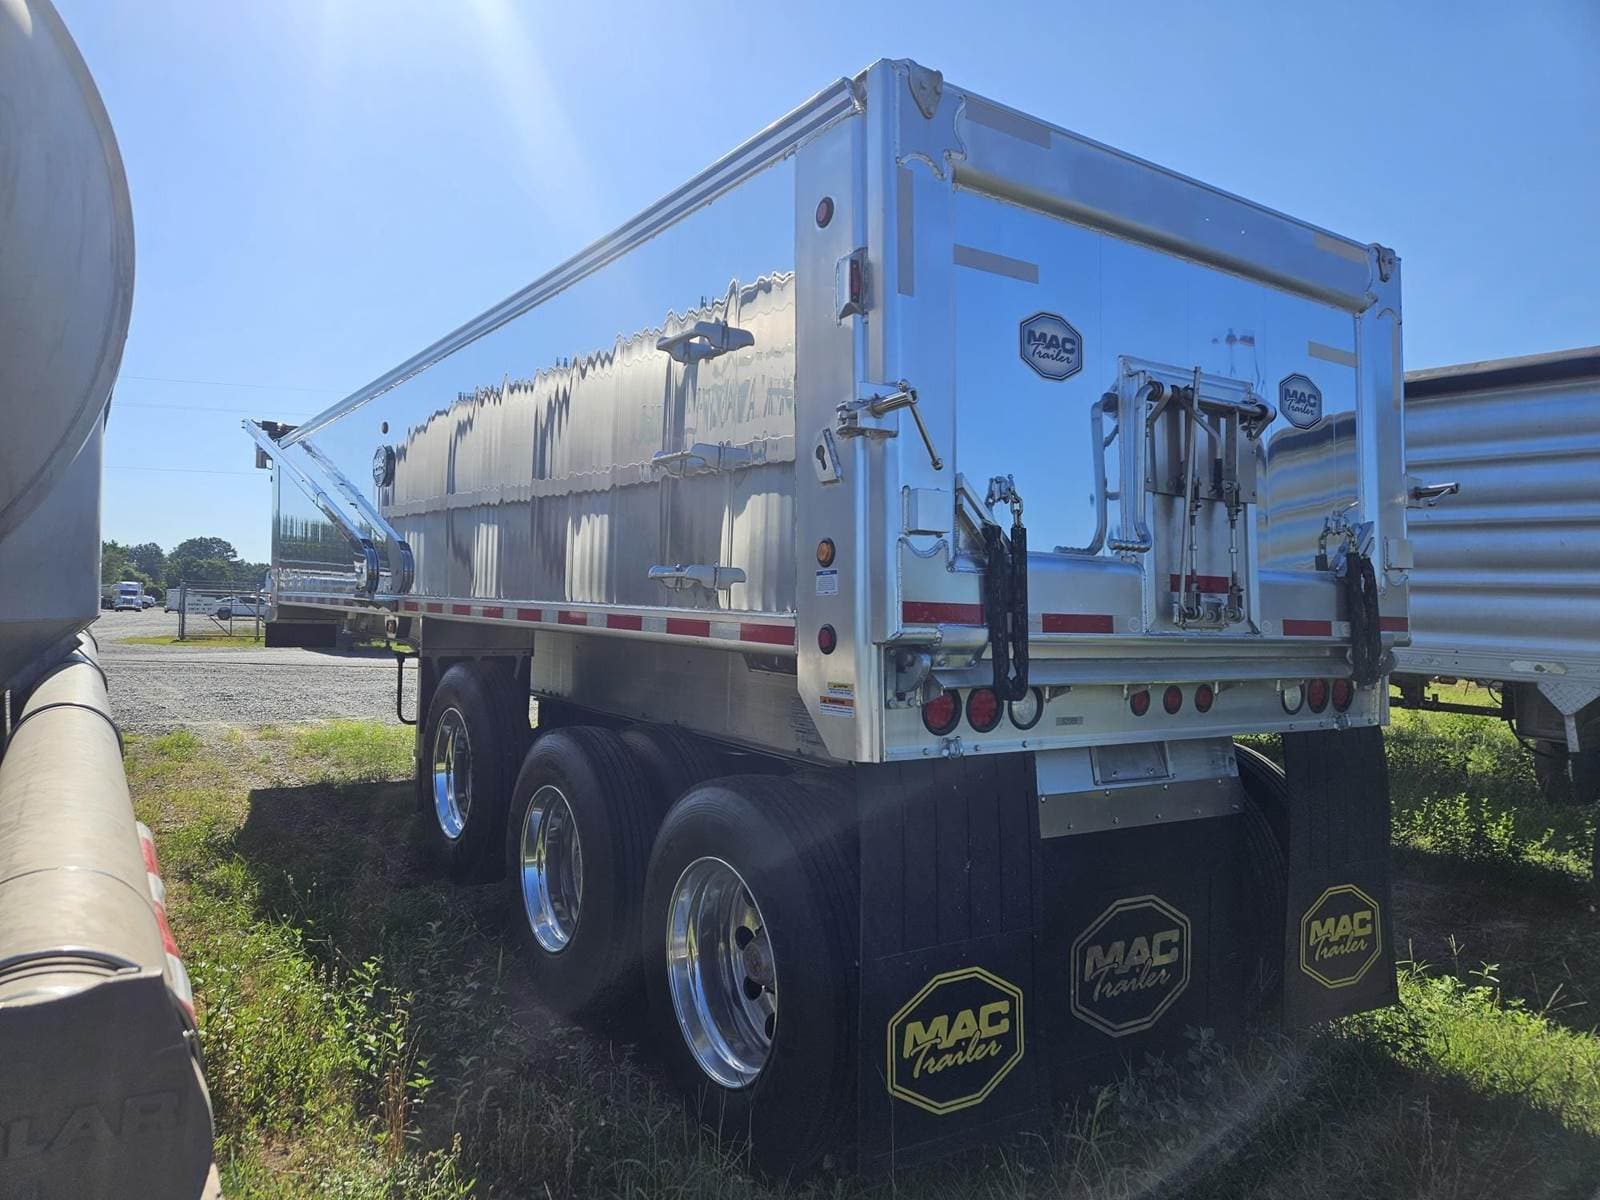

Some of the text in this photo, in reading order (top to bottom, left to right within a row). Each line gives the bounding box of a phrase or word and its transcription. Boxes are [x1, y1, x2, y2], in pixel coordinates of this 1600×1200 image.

[1027, 330, 1076, 354] MAC
[1031, 342, 1073, 364] Trailer
[1284, 388, 1317, 407] MAC
[1286, 399, 1314, 416] Trailer
[1309, 910, 1373, 946] MAC
[1314, 930, 1368, 961] Trailer
[1084, 929, 1180, 982] MAC
[1090, 957, 1171, 1002] Trailer
[903, 1000, 1010, 1059] MAC
[910, 1030, 1002, 1079] Trailer
[0, 1089, 184, 1160] LAR
